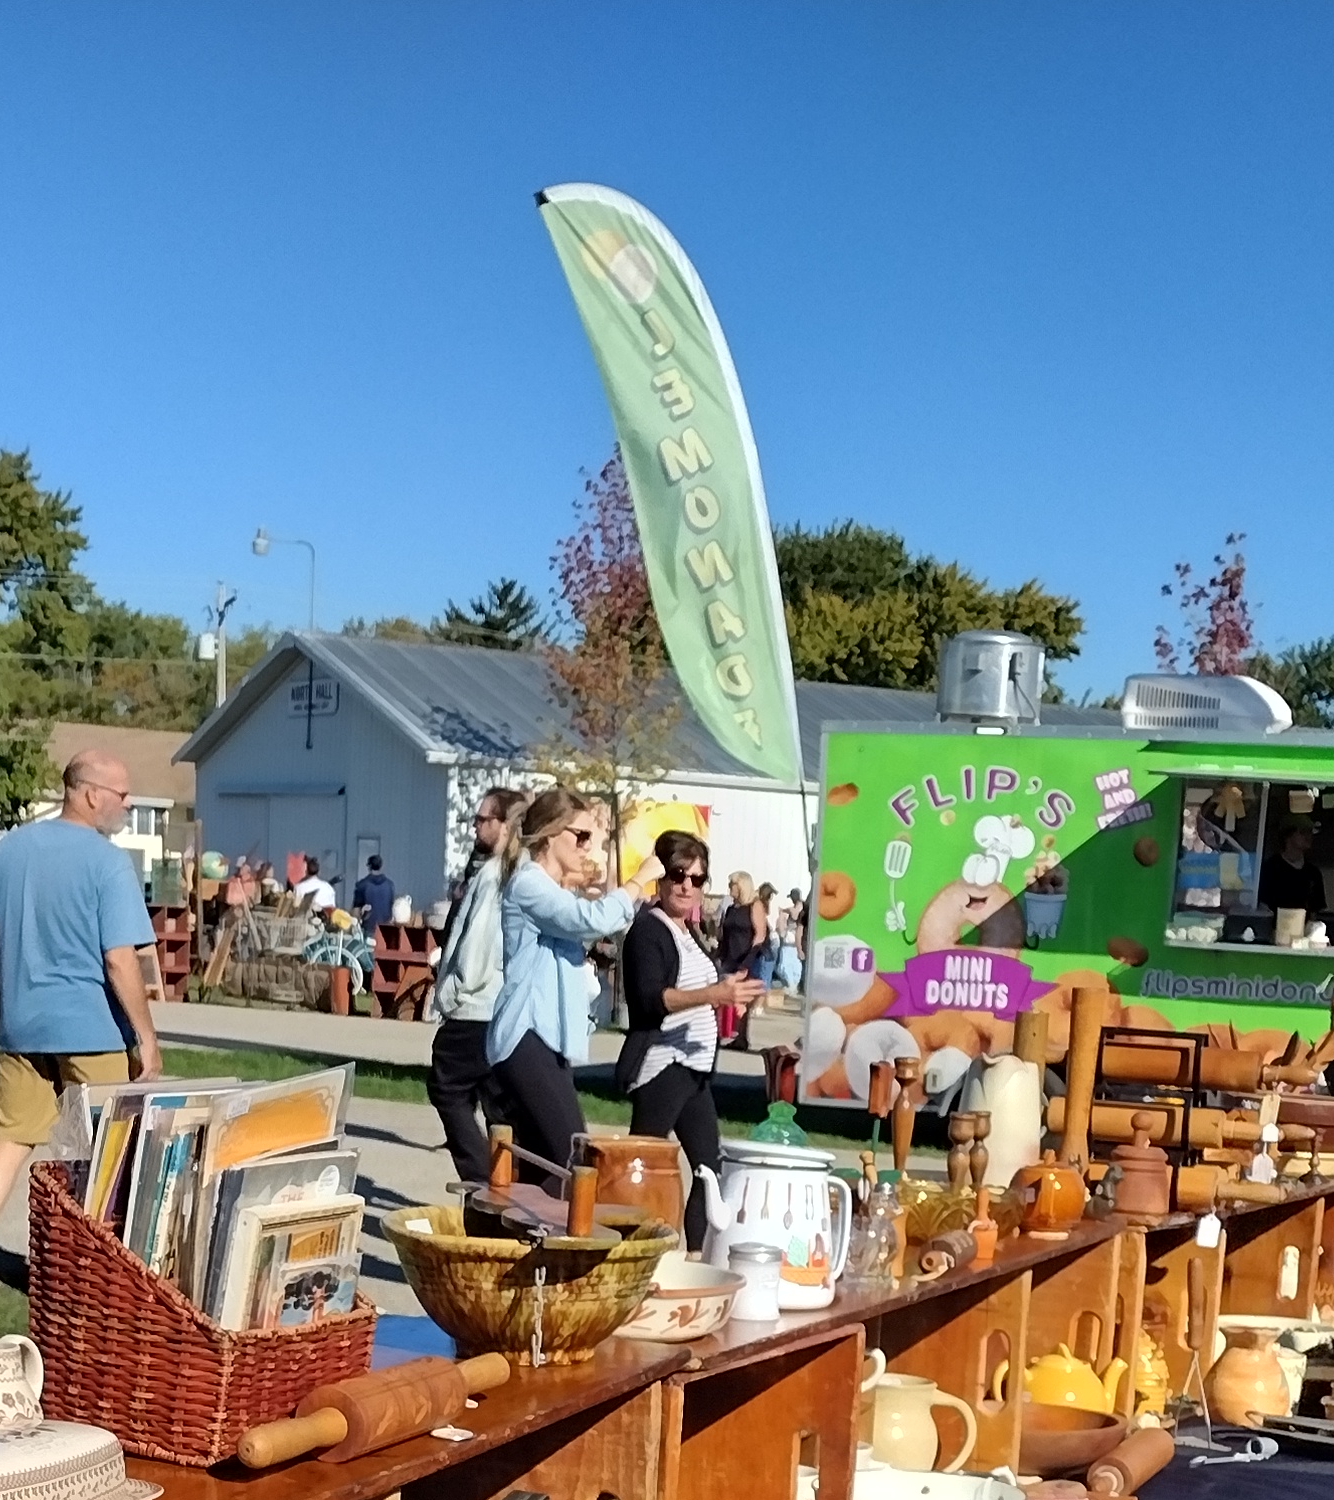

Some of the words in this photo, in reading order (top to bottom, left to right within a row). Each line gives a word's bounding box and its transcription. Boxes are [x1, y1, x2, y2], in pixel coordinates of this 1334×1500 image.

[1095, 769, 1129, 791] HOT
[889, 765, 1075, 829] FLIP'S
[1104, 788, 1136, 810] AND
[944, 954, 993, 982] MINI
[925, 979, 1009, 1009] DONUTS
